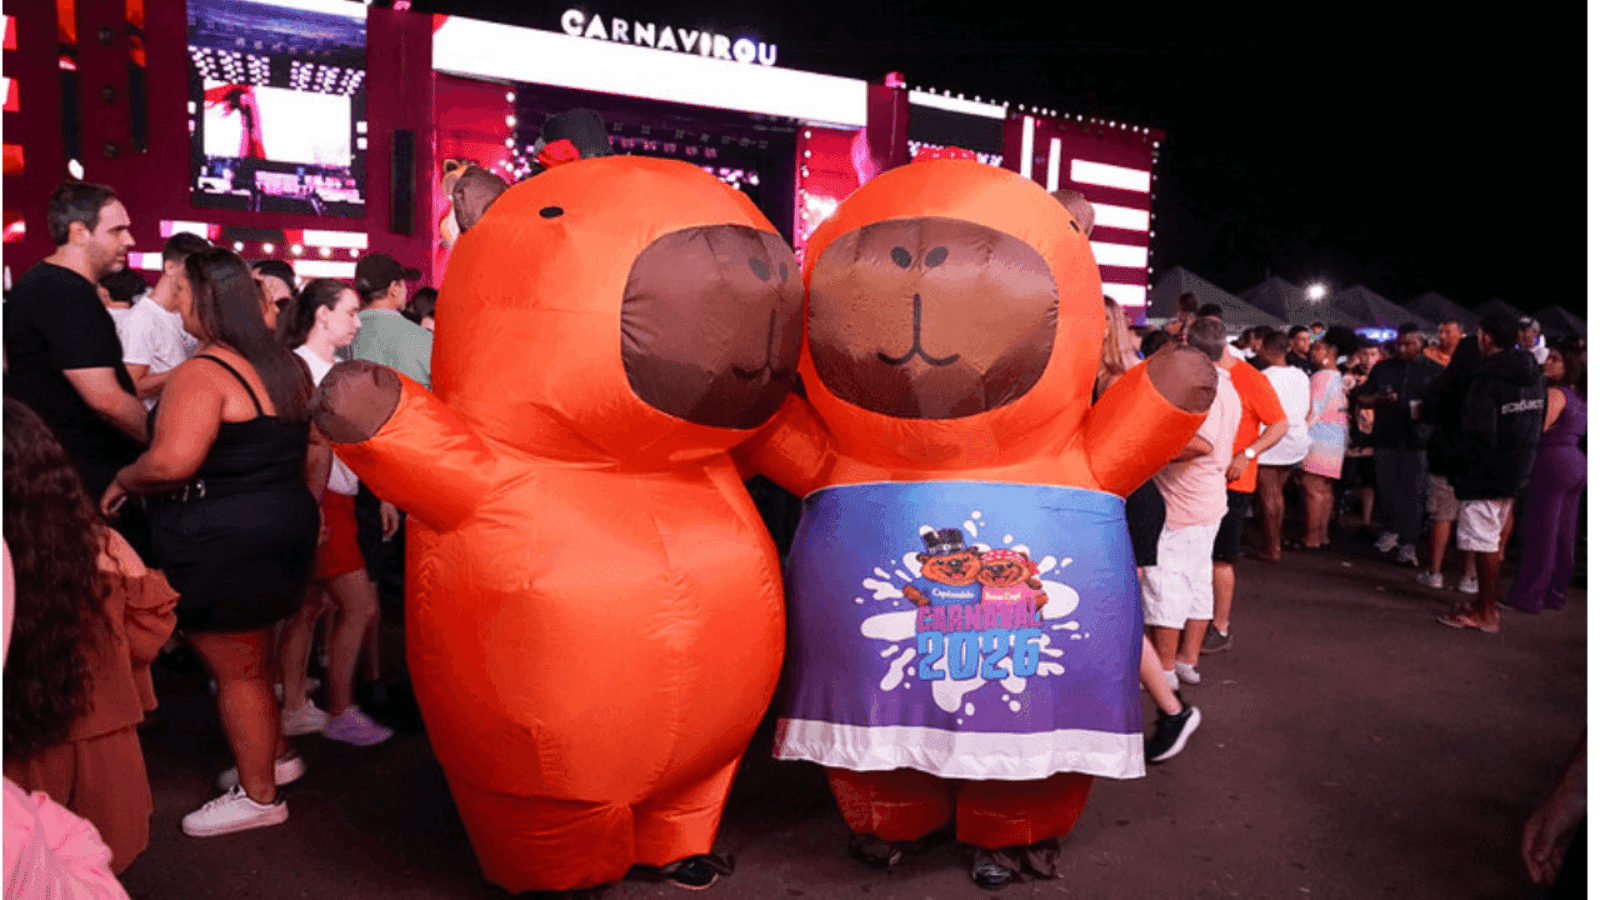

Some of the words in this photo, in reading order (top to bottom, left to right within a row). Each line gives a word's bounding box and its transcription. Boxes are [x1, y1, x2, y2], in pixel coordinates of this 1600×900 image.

[561, 9, 777, 66] CARNAVIROU
[916, 602, 1041, 633] CARNAVAL
[917, 629, 1042, 681] 2026
